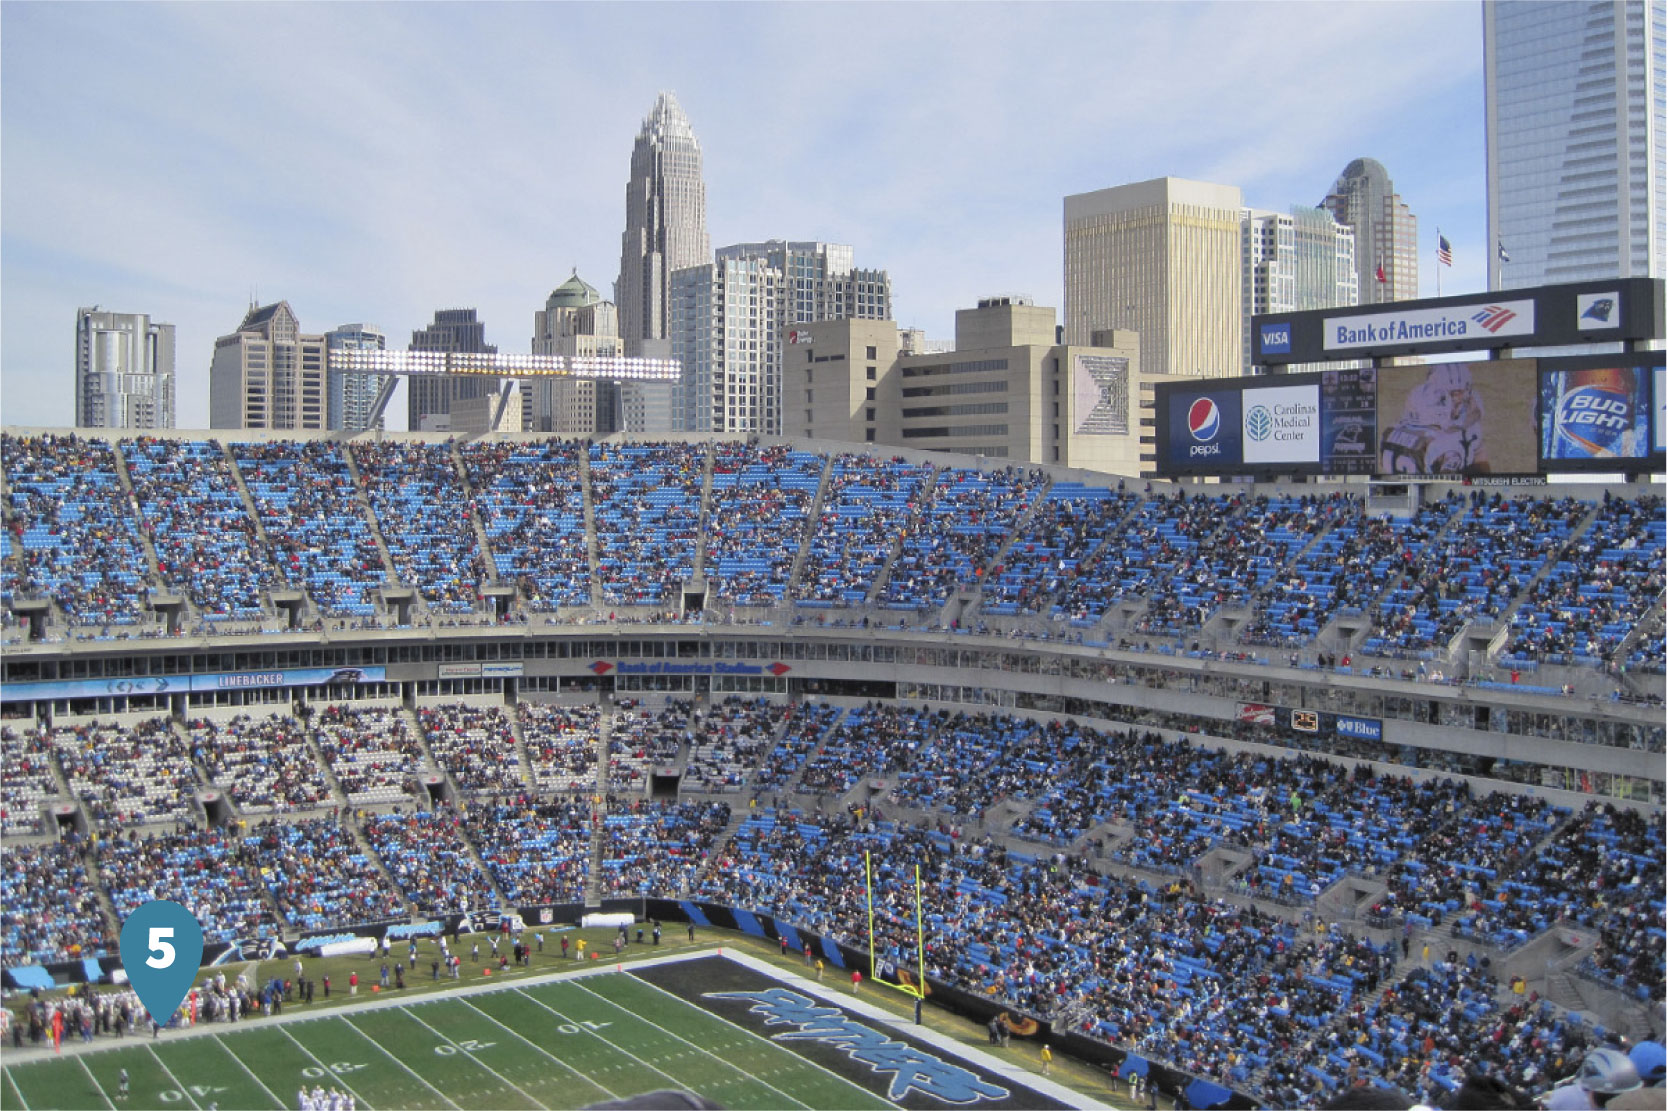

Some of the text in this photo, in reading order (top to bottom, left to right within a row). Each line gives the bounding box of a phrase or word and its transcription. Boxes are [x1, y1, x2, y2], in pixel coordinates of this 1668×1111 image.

[1337, 317, 1467, 343] Bank of America
[1262, 332, 1288, 345] VISA
[1274, 403, 1316, 415] Carolinas
[1570, 395, 1627, 414] BUD
[1274, 416, 1311, 428] Medical
[1560, 411, 1629, 429] LIGHT
[1274, 430, 1305, 441] Center
[1190, 442, 1219, 457] pepsi
[219, 673, 284, 687] LINEBACKER
